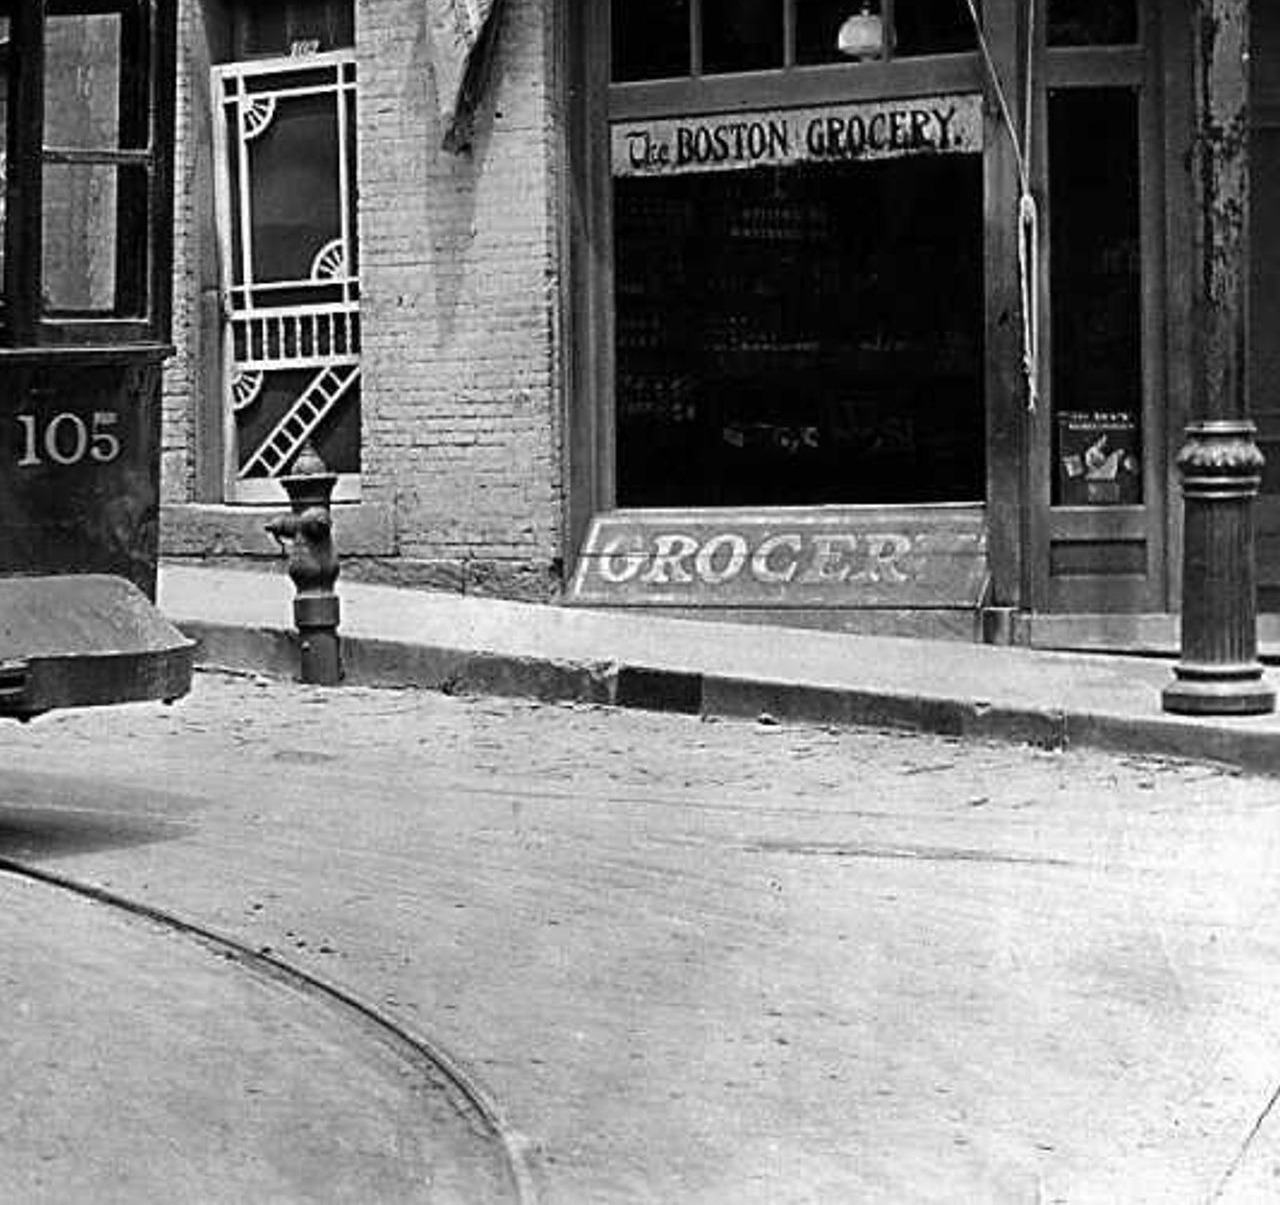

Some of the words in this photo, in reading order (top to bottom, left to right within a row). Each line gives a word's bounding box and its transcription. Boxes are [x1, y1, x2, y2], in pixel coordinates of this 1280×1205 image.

[626, 131, 669, 168] The
[677, 119, 790, 164] BOSTON
[17, 412, 120, 466] 105
